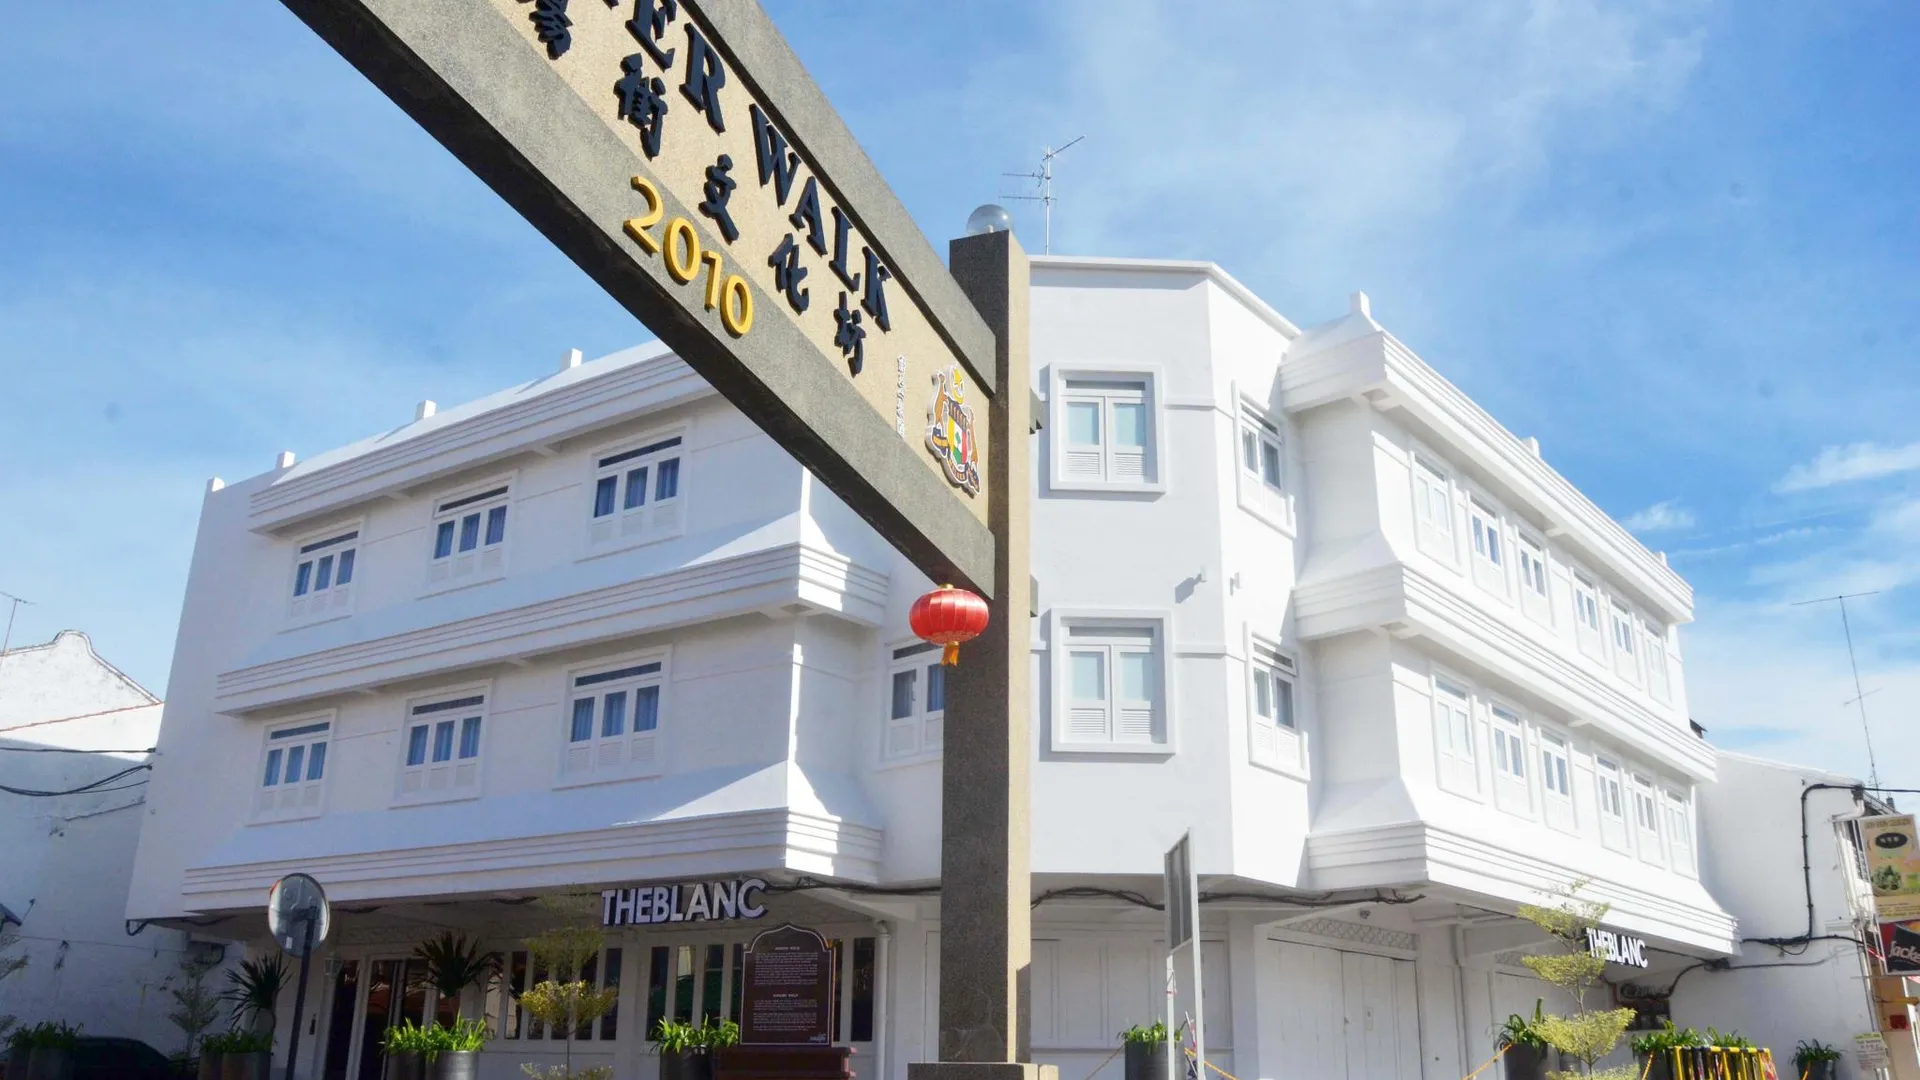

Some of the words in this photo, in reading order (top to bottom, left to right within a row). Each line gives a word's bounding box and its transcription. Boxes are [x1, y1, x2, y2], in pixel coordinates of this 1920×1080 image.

[604, 0, 726, 136] ER
[749, 103, 892, 333] WALK
[622, 176, 754, 337] 2010
